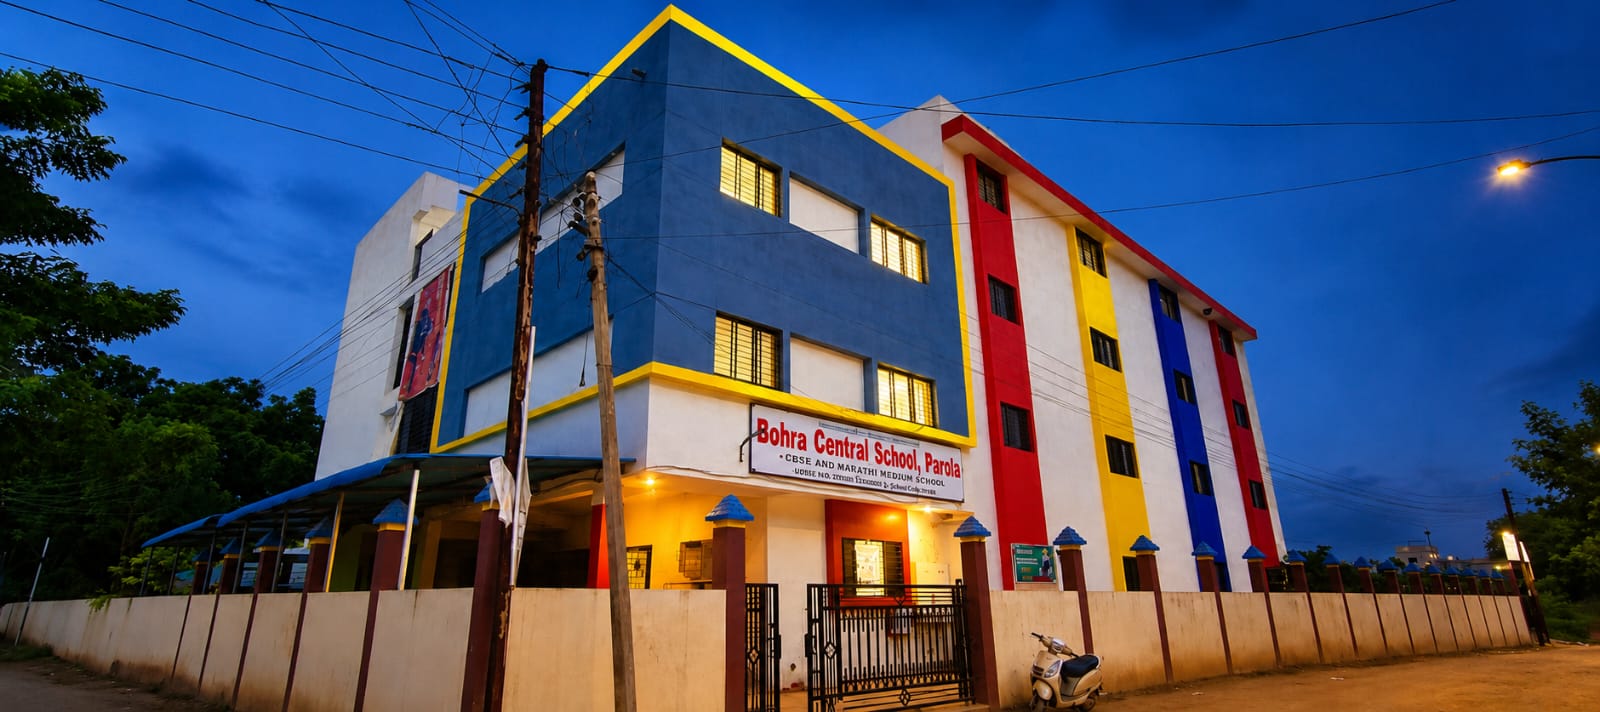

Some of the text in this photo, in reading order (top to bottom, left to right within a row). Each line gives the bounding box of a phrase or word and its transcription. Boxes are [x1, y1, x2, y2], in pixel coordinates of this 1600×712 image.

[757, 416, 807, 452] Bohra
[814, 428, 869, 462] Central
[874, 441, 921, 476] School,
[925, 452, 961, 479] Parola
[785, 453, 812, 466] CBSE
[815, 459, 835, 470] AND
[837, 462, 878, 477] MARATHI
[880, 469, 913, 482] MEDIUM
[915, 476, 945, 487] SCHOOL
